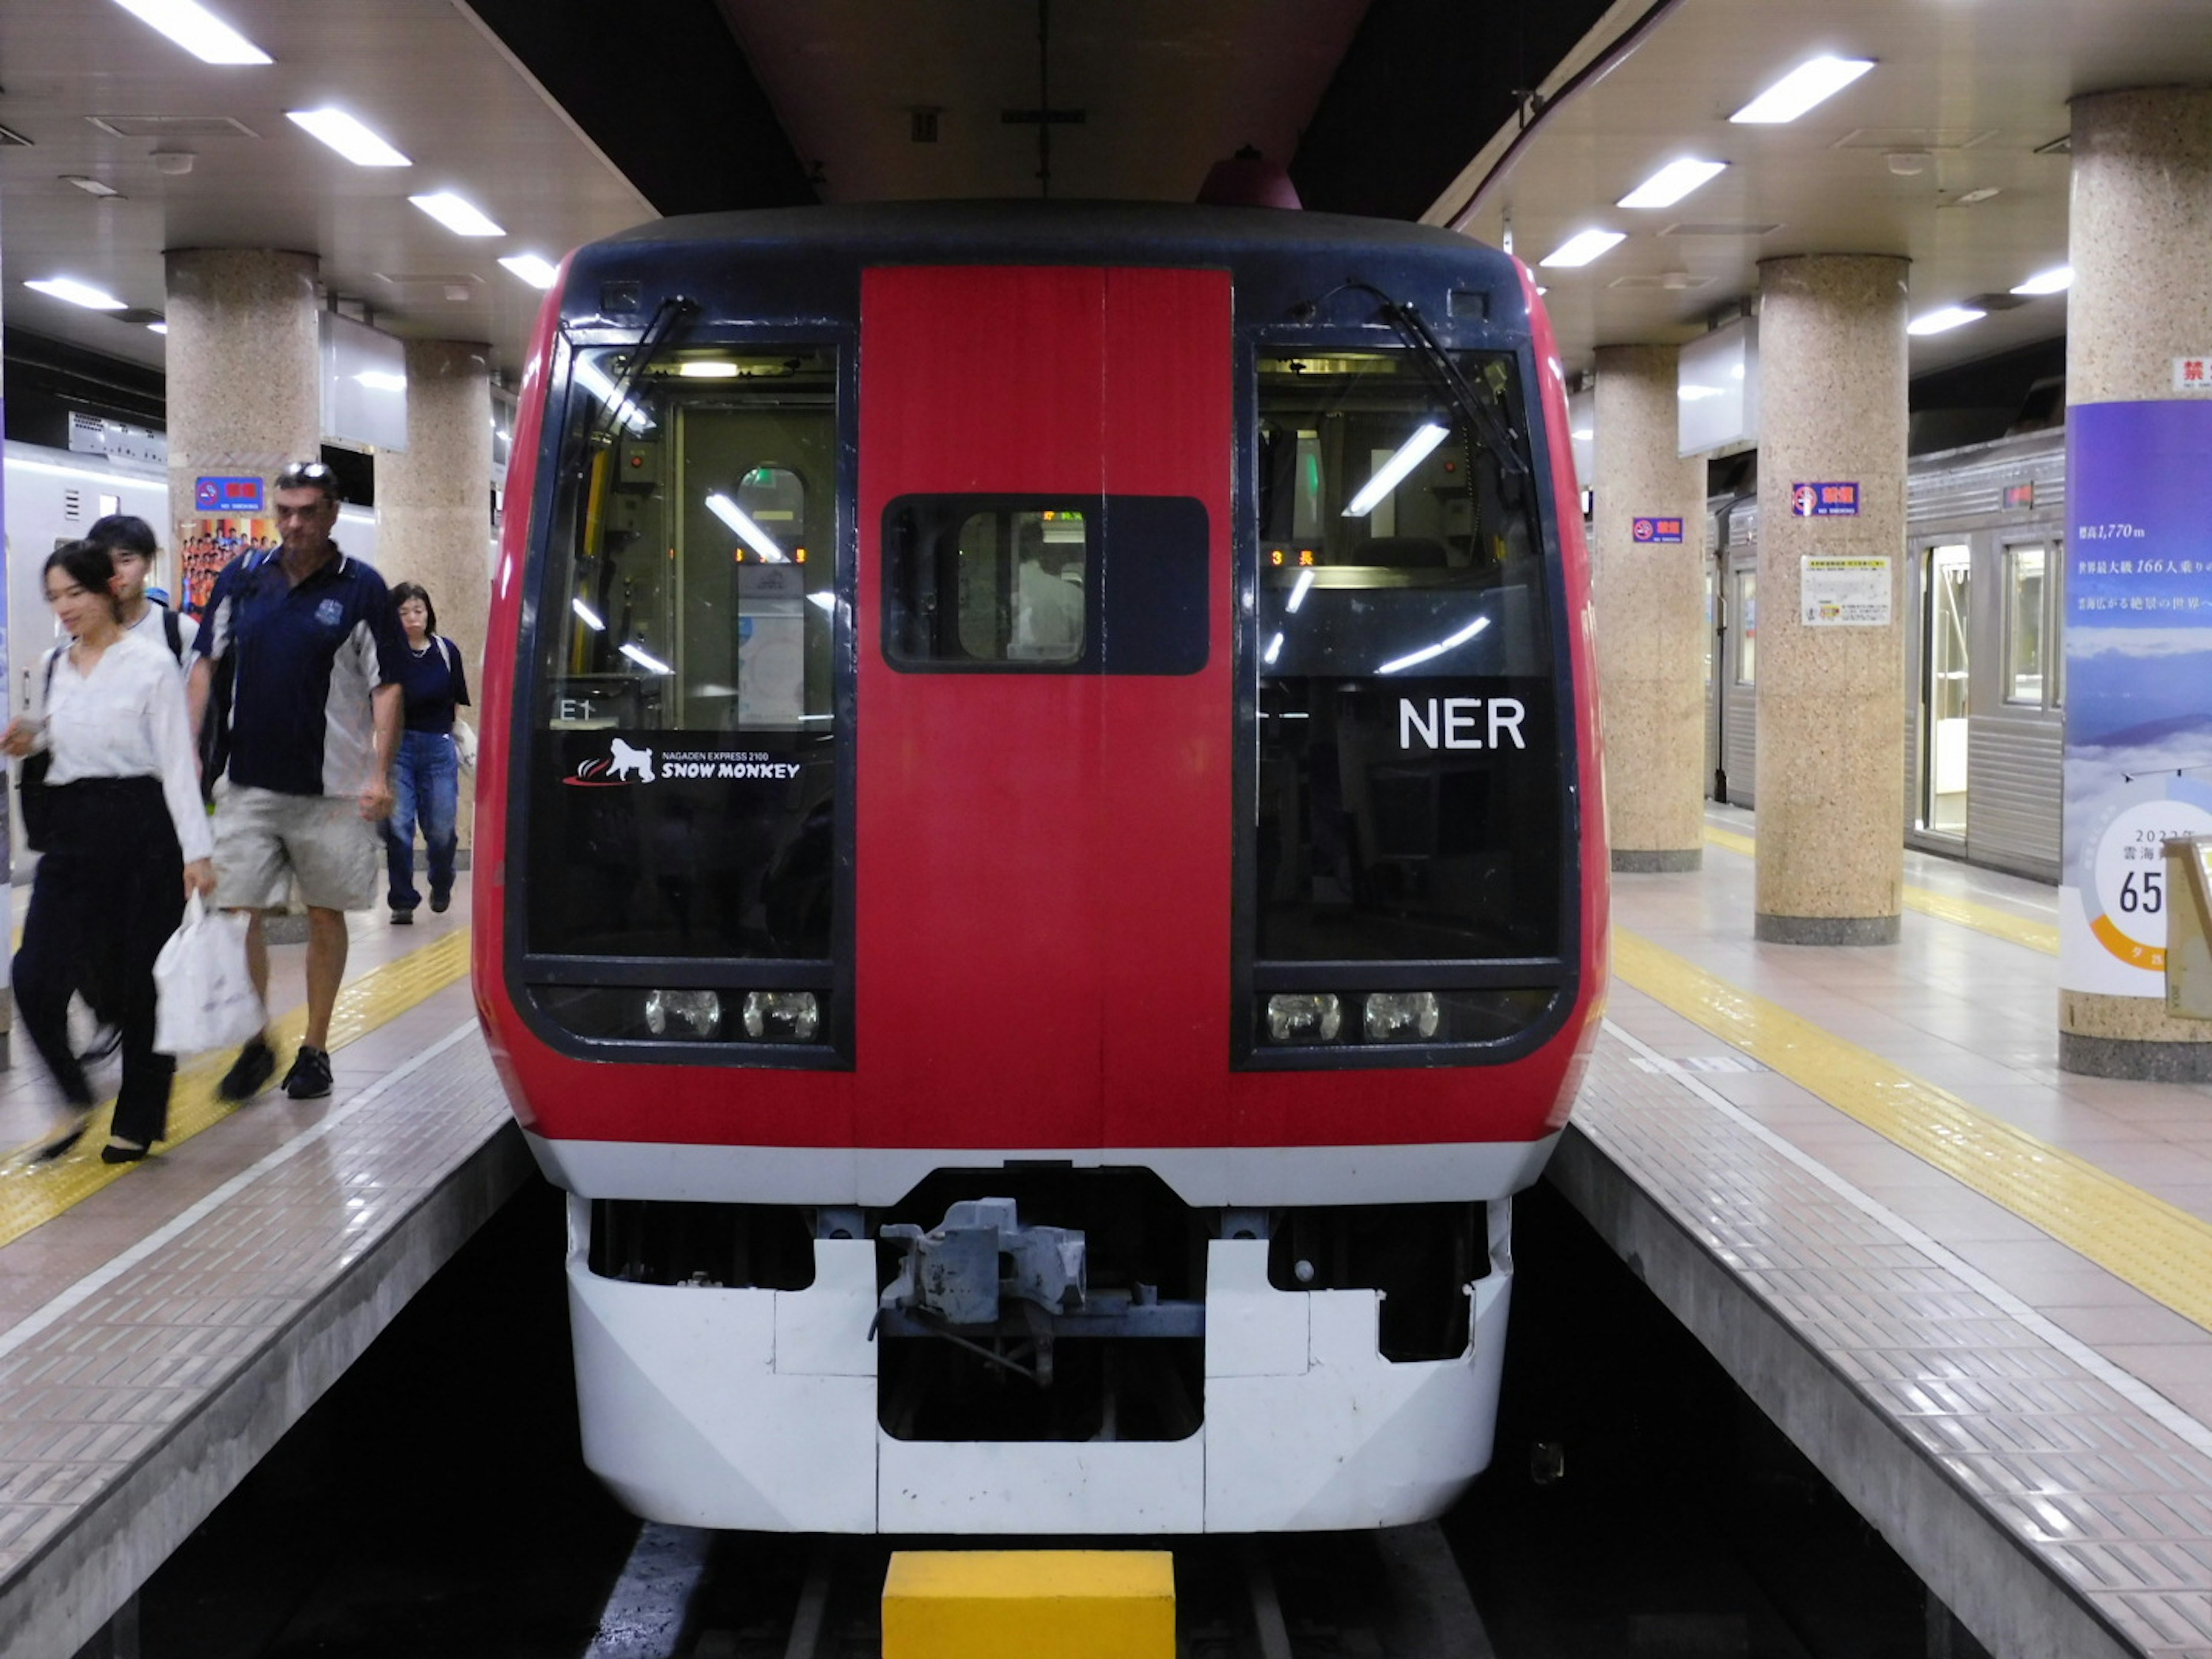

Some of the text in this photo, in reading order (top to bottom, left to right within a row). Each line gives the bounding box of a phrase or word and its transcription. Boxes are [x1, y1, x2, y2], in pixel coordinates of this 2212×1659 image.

[2184, 361, 2212, 381] 禁
[1271, 550, 1282, 565] 3
[560, 699, 590, 721] E1
[1400, 698, 1526, 749] NER
[662, 751, 769, 762] NAGADEN EXPRESS 2100
[662, 762, 800, 779] SNOW MONKEY
[2124, 846, 2165, 860] 雲海
[2120, 870, 2162, 913] 65
